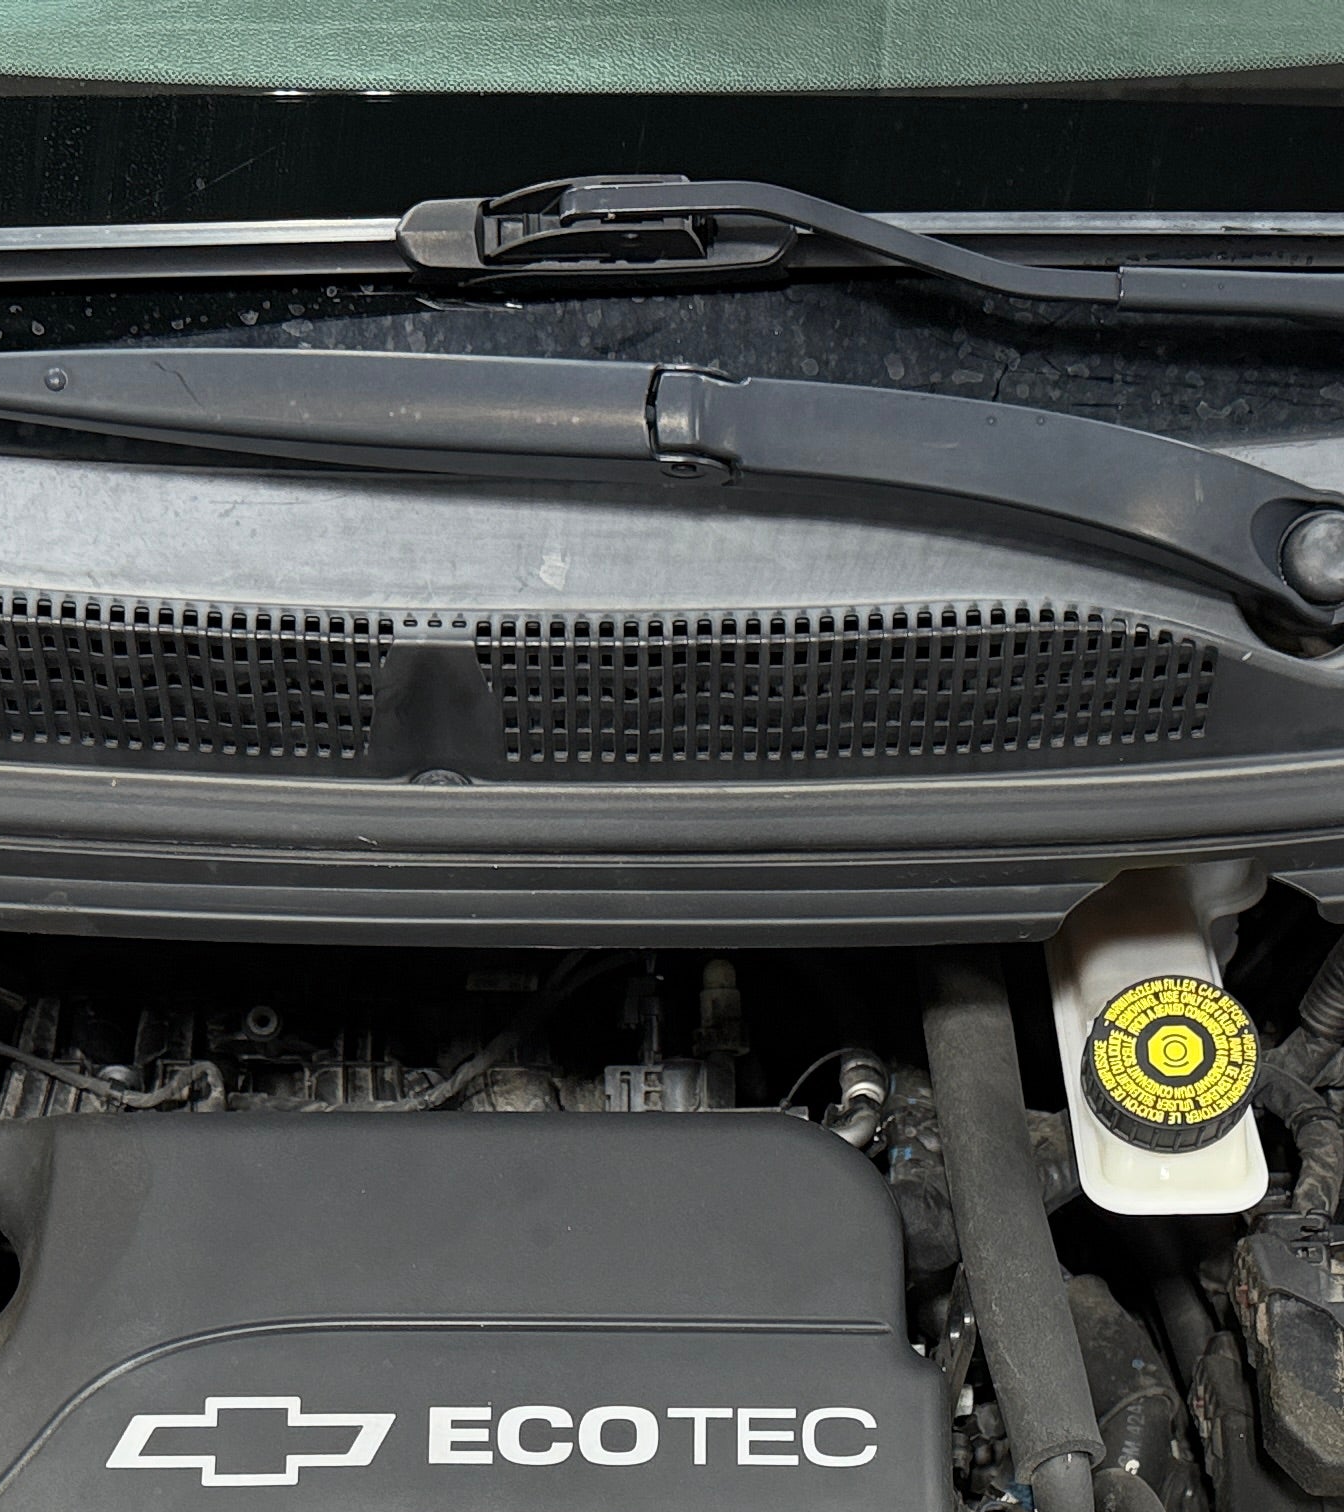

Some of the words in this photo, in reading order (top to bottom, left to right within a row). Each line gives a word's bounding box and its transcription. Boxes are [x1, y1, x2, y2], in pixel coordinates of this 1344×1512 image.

[1159, 991, 1179, 1003] USE
[1181, 992, 1203, 1006] ONLY
[1163, 978, 1197, 993] FILLER
[1198, 984, 1221, 999] CAP
[1218, 996, 1249, 1028] BEFORE
[1168, 1112, 1182, 1125] LE
[429, 1406, 878, 1468] ECOTEC
